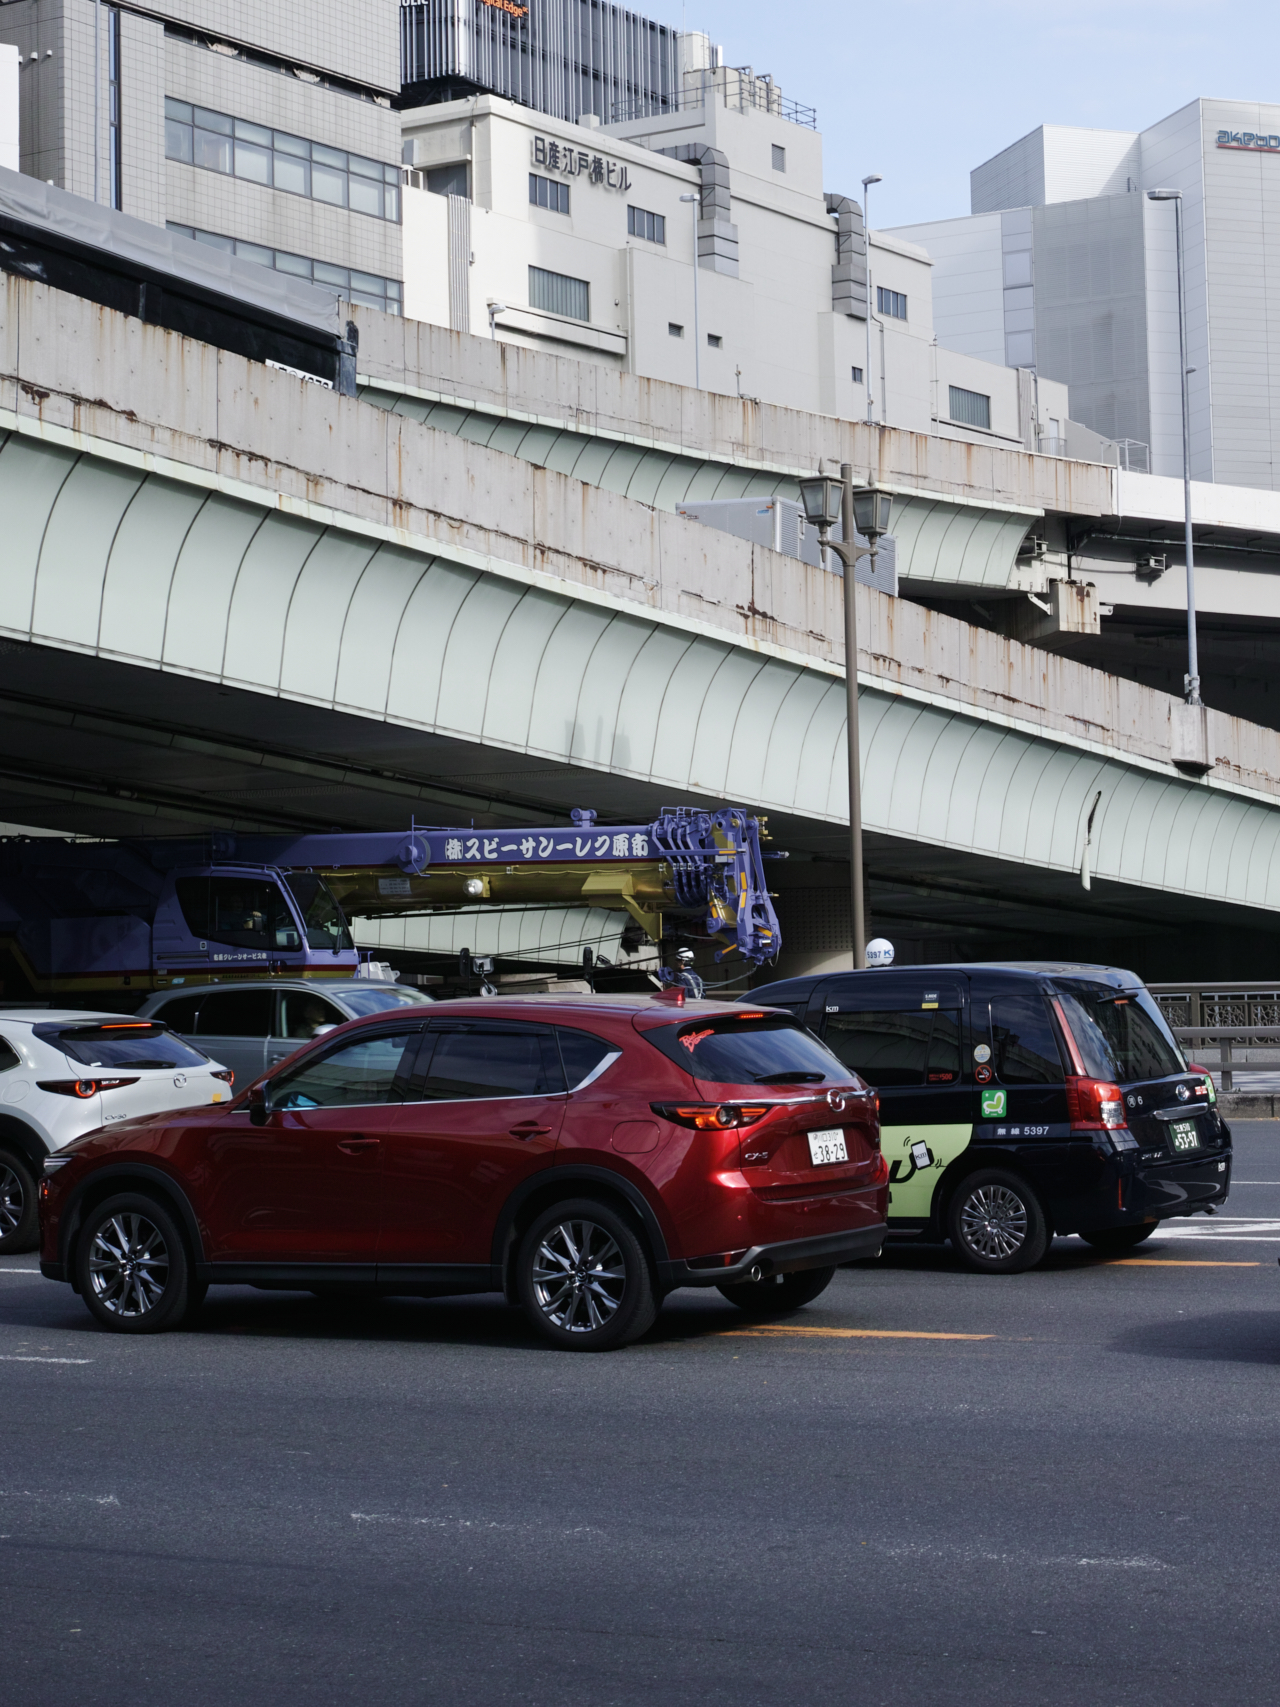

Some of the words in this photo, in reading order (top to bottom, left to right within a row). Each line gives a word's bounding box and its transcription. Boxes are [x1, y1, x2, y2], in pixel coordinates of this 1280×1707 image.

[503, 0, 523, 17] Edge
[534, 135, 632, 191] 日産江戸橋ビル
[1024, 1126, 1049, 1135] 5397
[745, 1152, 768, 1160] CX-5
[818, 1143, 846, 1163] 38-29
